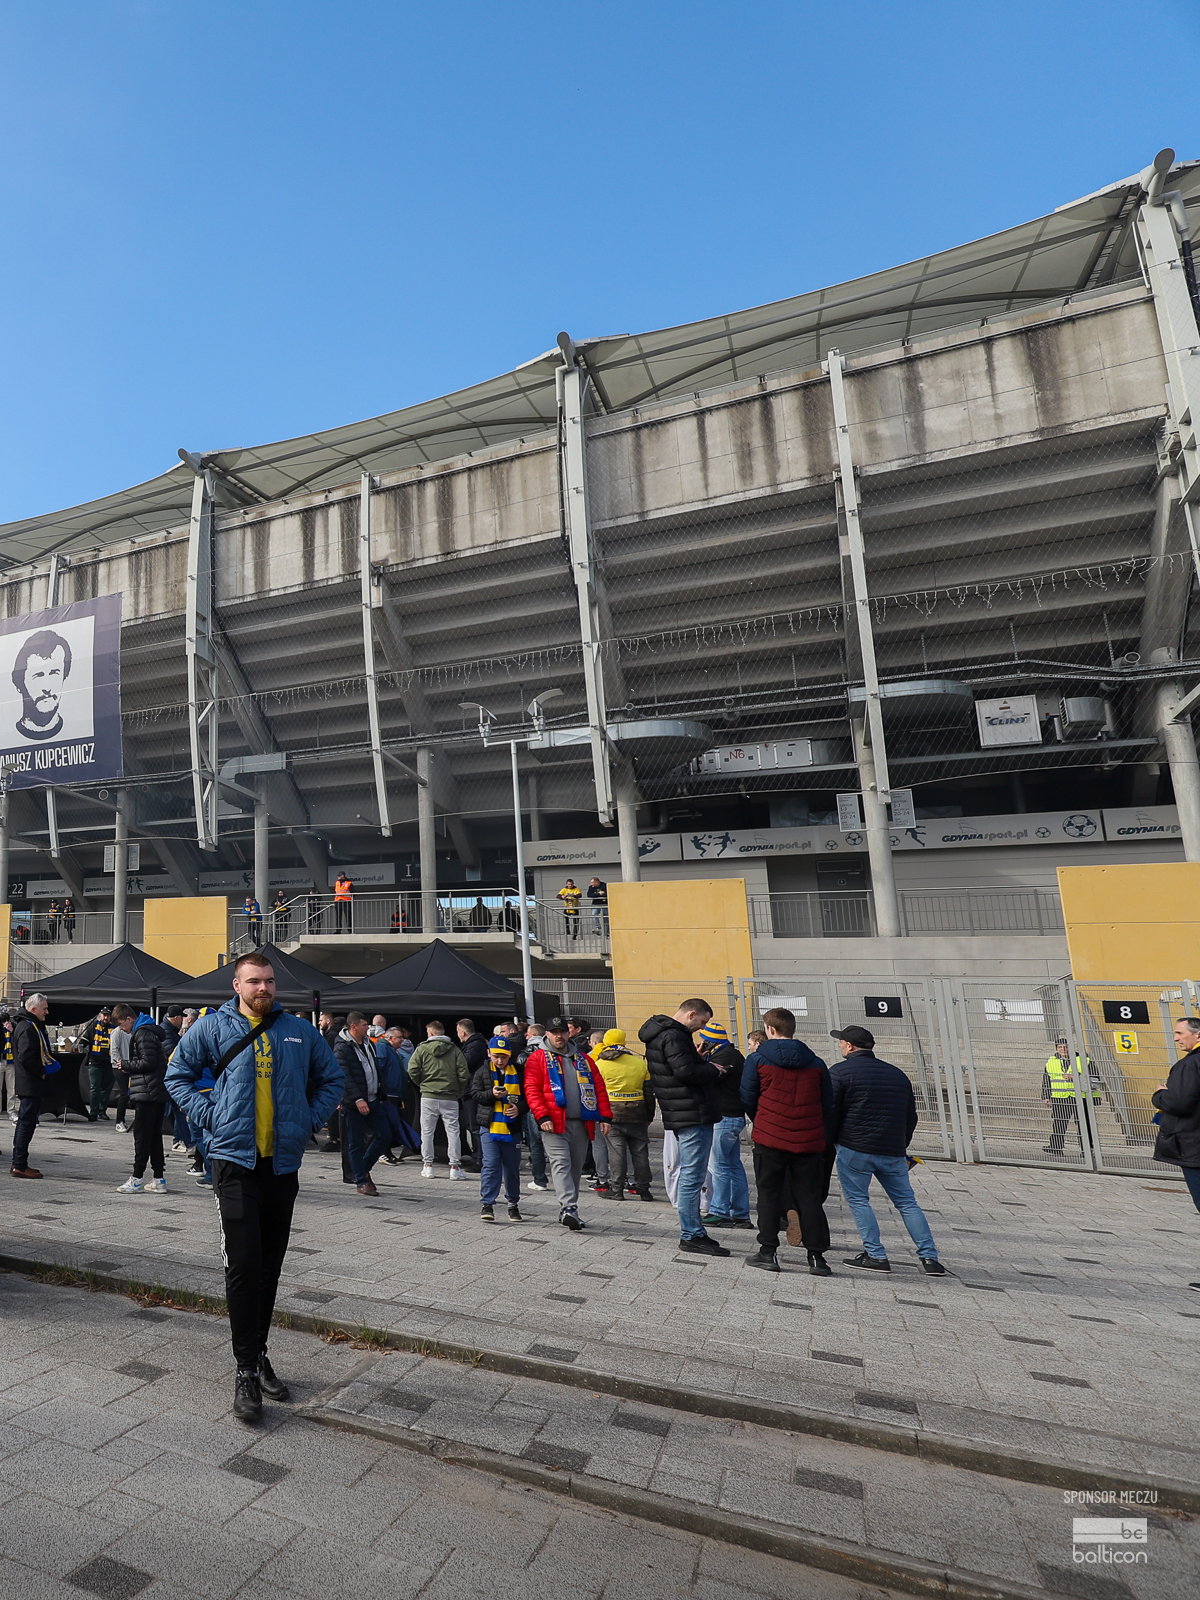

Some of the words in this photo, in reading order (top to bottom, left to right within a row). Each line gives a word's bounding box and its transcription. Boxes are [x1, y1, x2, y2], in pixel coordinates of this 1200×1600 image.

[988, 716, 1028, 726] CLINT
[35, 742, 95, 770] KUPCEWICZ
[1117, 824, 1181, 836] GDYNIAsp
[12, 883, 23, 894] 22
[877, 1001, 889, 1014] 9
[1120, 1006, 1132, 1019] 8
[1121, 1034, 1132, 1049] 5
